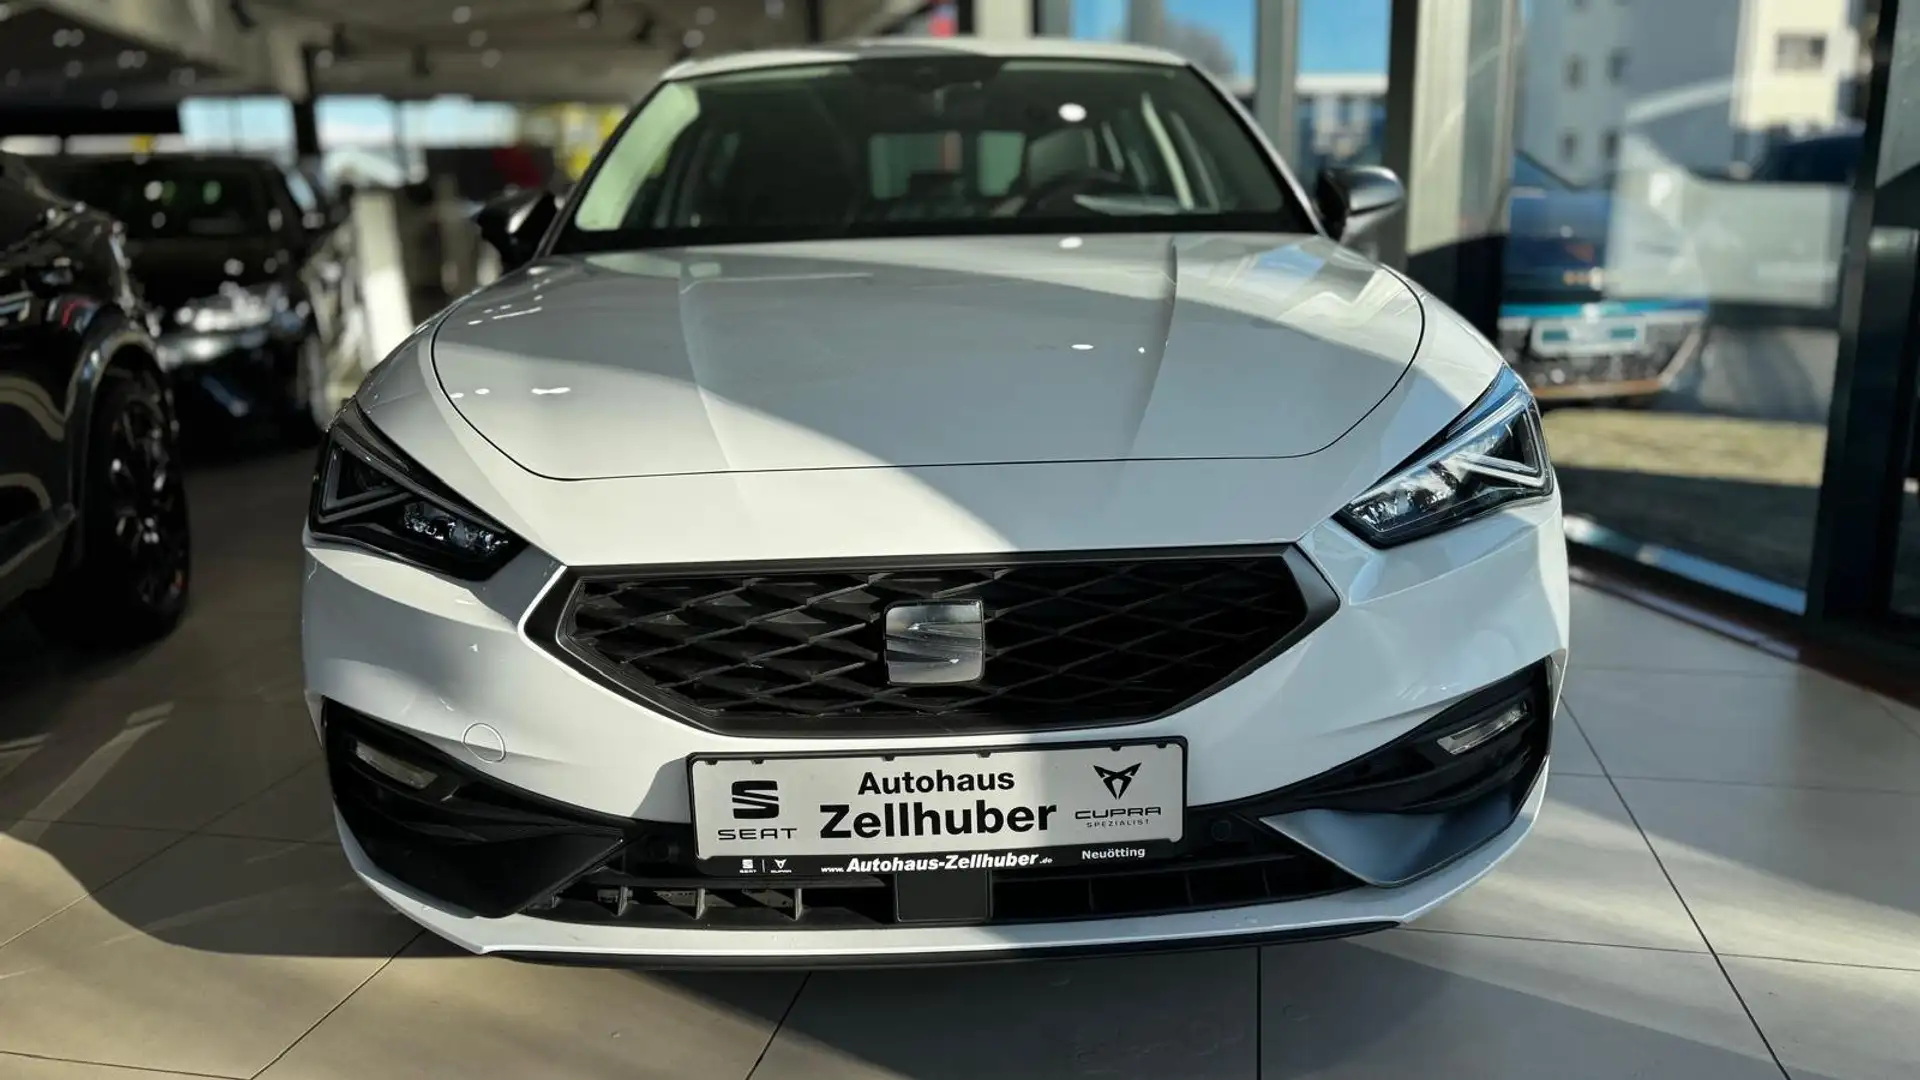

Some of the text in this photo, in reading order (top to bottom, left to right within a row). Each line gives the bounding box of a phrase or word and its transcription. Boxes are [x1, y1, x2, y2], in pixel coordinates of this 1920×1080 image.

[857, 769, 1015, 796] Autohaus
[819, 800, 1057, 839] Zellhuber
[1075, 806, 1162, 820] CUPRA
[1086, 819, 1150, 828] SPEZIALIST
[717, 828, 798, 840] SEAT
[1081, 847, 1146, 860] Neuötting
